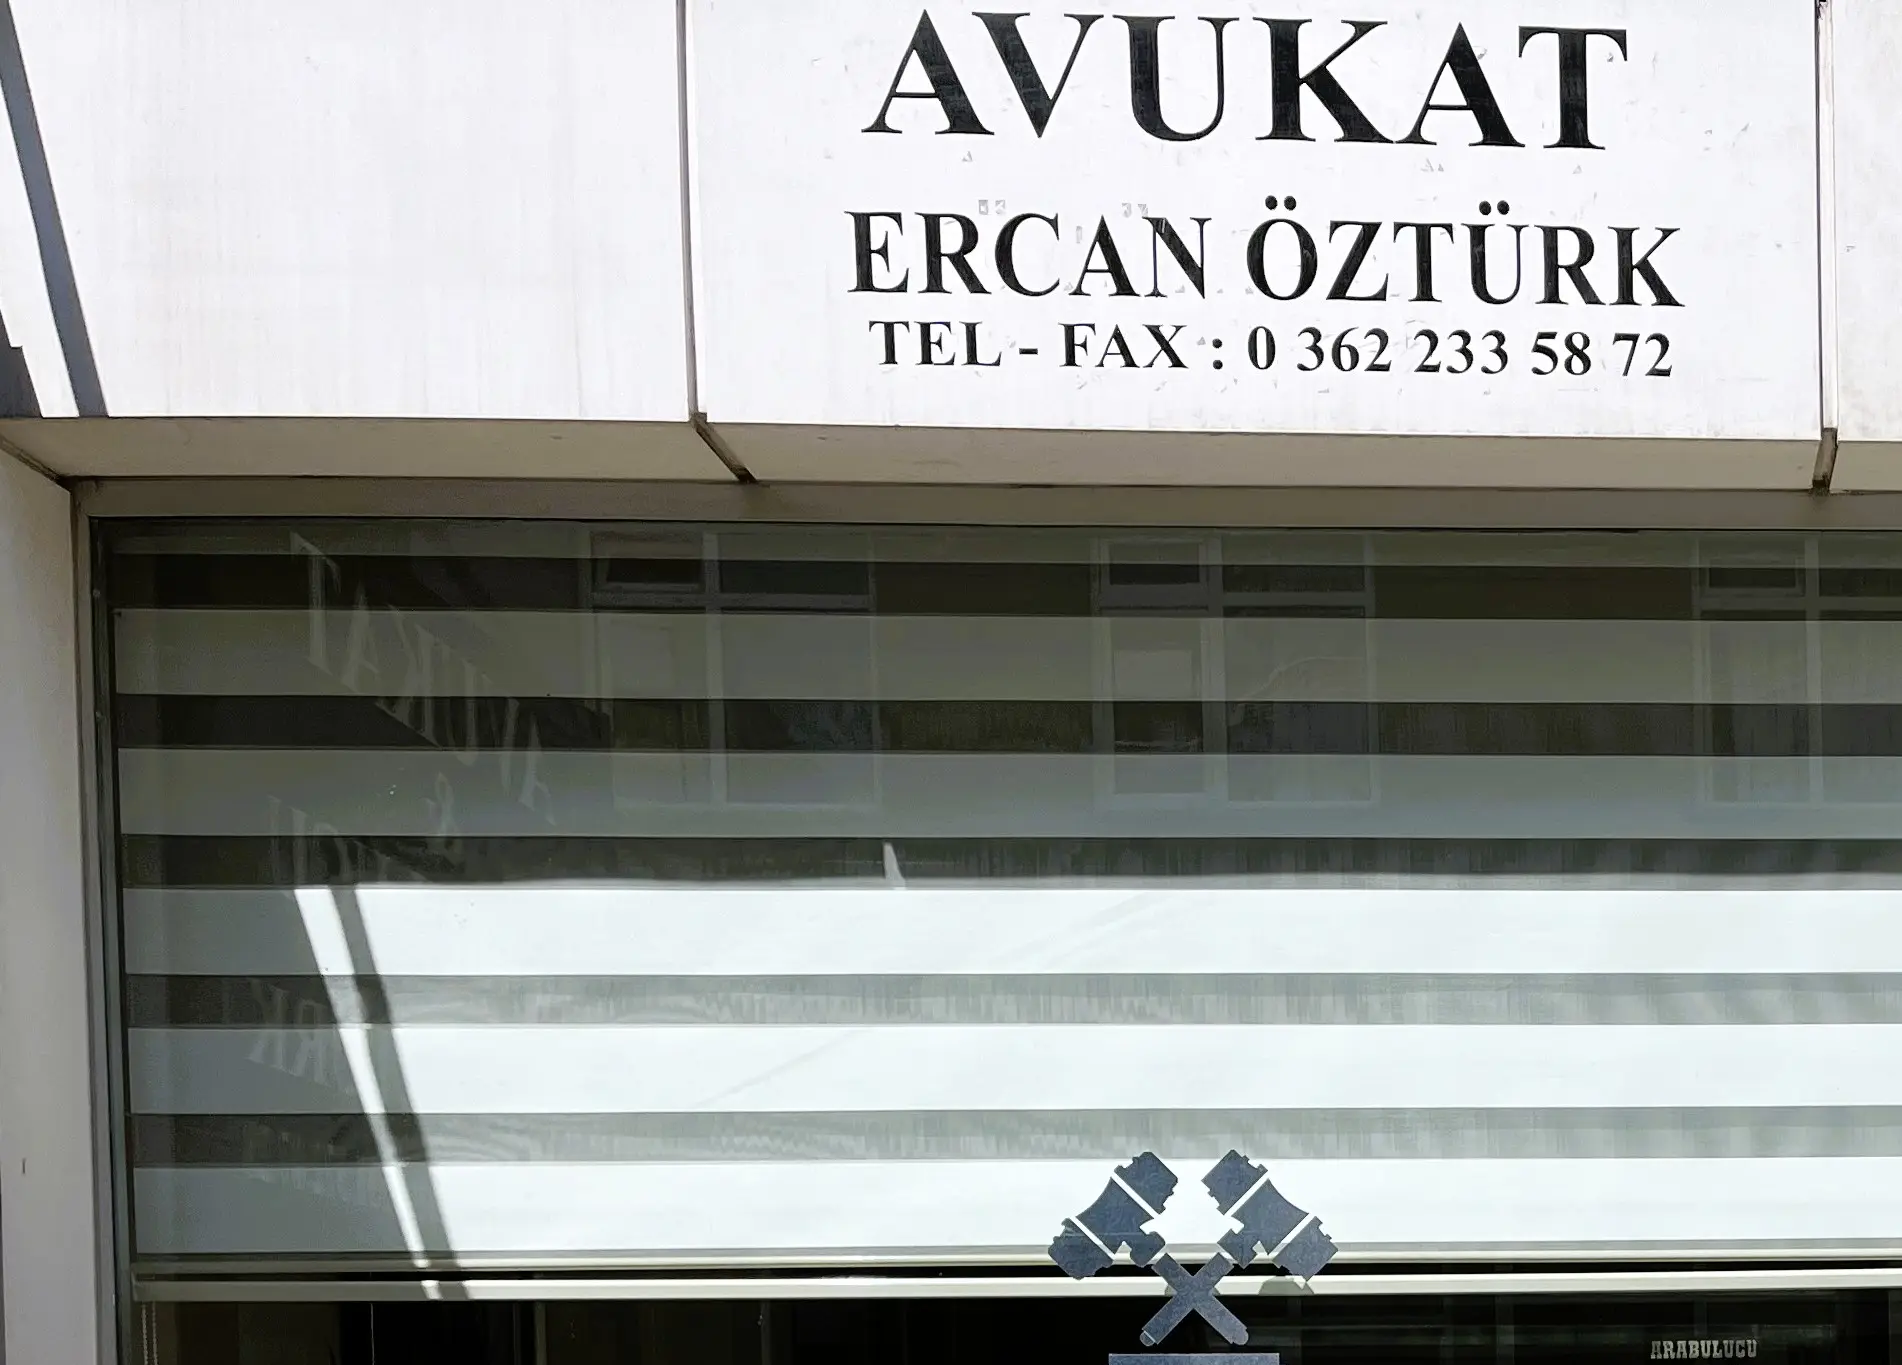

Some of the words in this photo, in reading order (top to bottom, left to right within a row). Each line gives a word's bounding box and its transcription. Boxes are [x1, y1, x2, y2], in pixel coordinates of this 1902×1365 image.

[861, 9, 1628, 151] AVUKAT
[845, 211, 1212, 299] ERCAN
[1246, 195, 1685, 307] ÖZTÜRK
[868, 320, 1002, 367] TEL
[1060, 323, 1188, 369] FAX
[1247, 326, 1276, 370] 0
[1297, 327, 1392, 372] 362
[1413, 329, 1508, 375] 233
[1531, 331, 1592, 376] 58
[1612, 333, 1672, 377] 72
[1650, 1339, 1758, 1360] ARABULUCU
